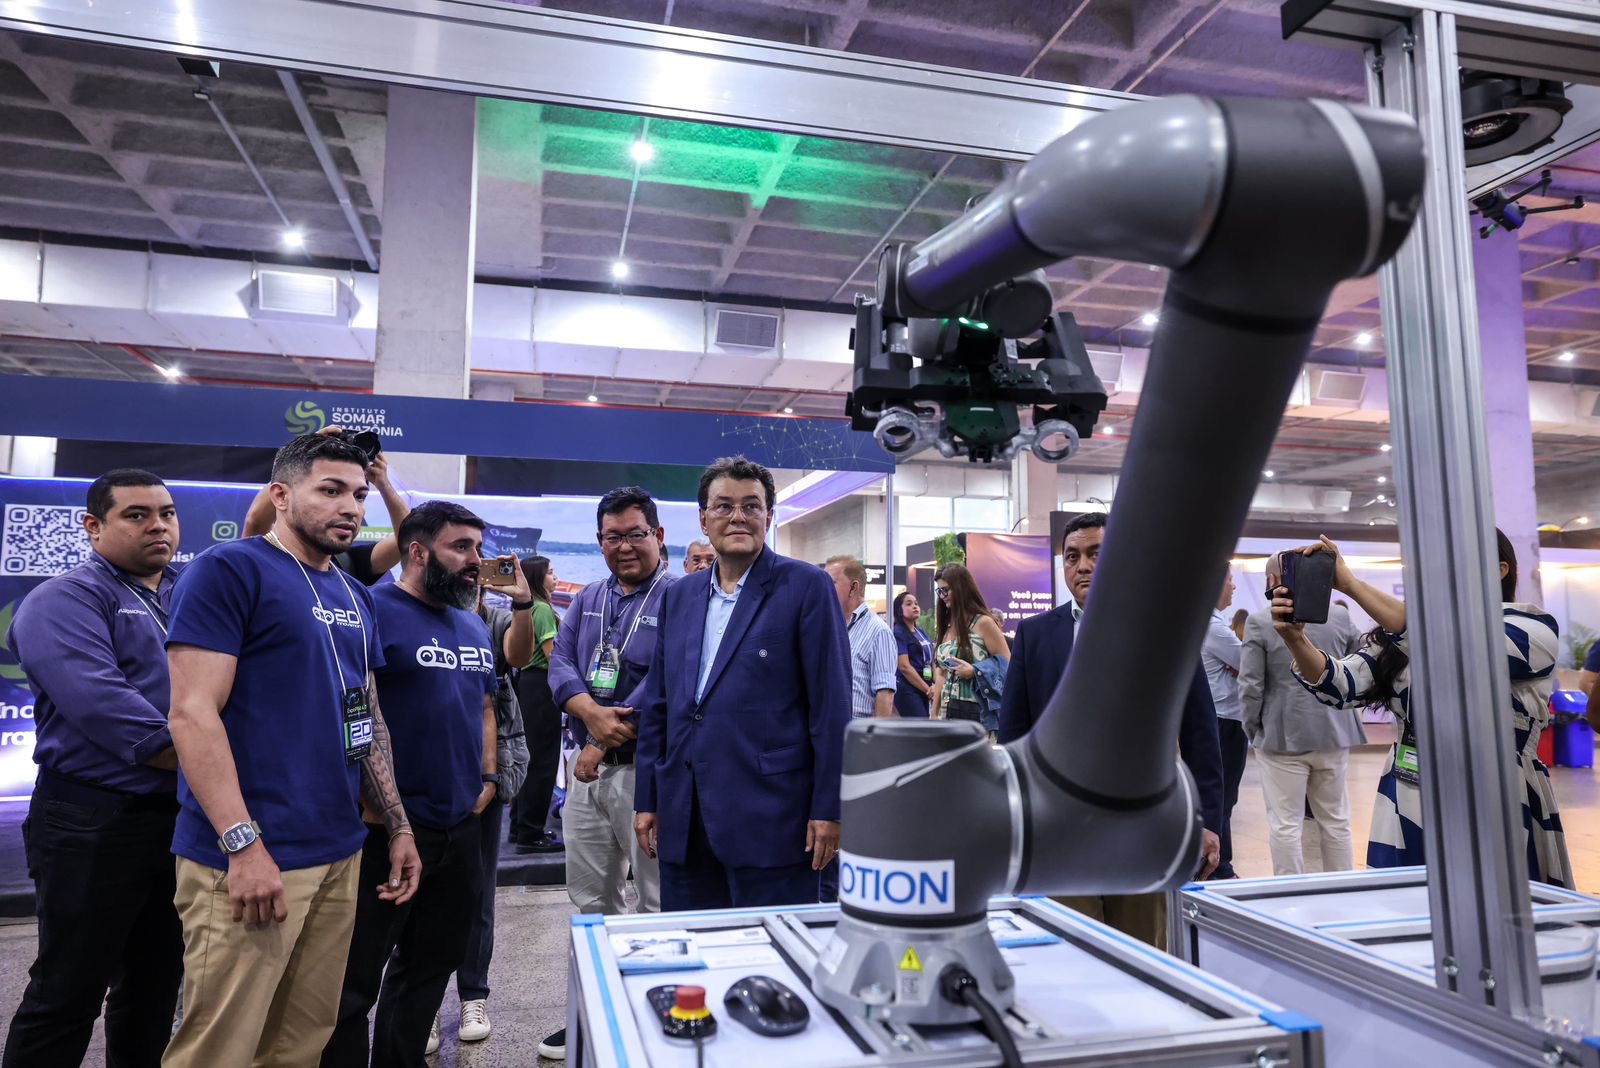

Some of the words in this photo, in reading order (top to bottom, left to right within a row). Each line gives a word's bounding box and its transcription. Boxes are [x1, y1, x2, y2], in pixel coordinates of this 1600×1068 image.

[332, 412, 385, 425] SOMAR
[340, 424, 403, 437] MAZÔNIA
[1011, 591, 1031, 599] Você
[334, 608, 361, 625] 2D
[458, 646, 494, 669] 2D
[351, 722, 371, 739] 2D
